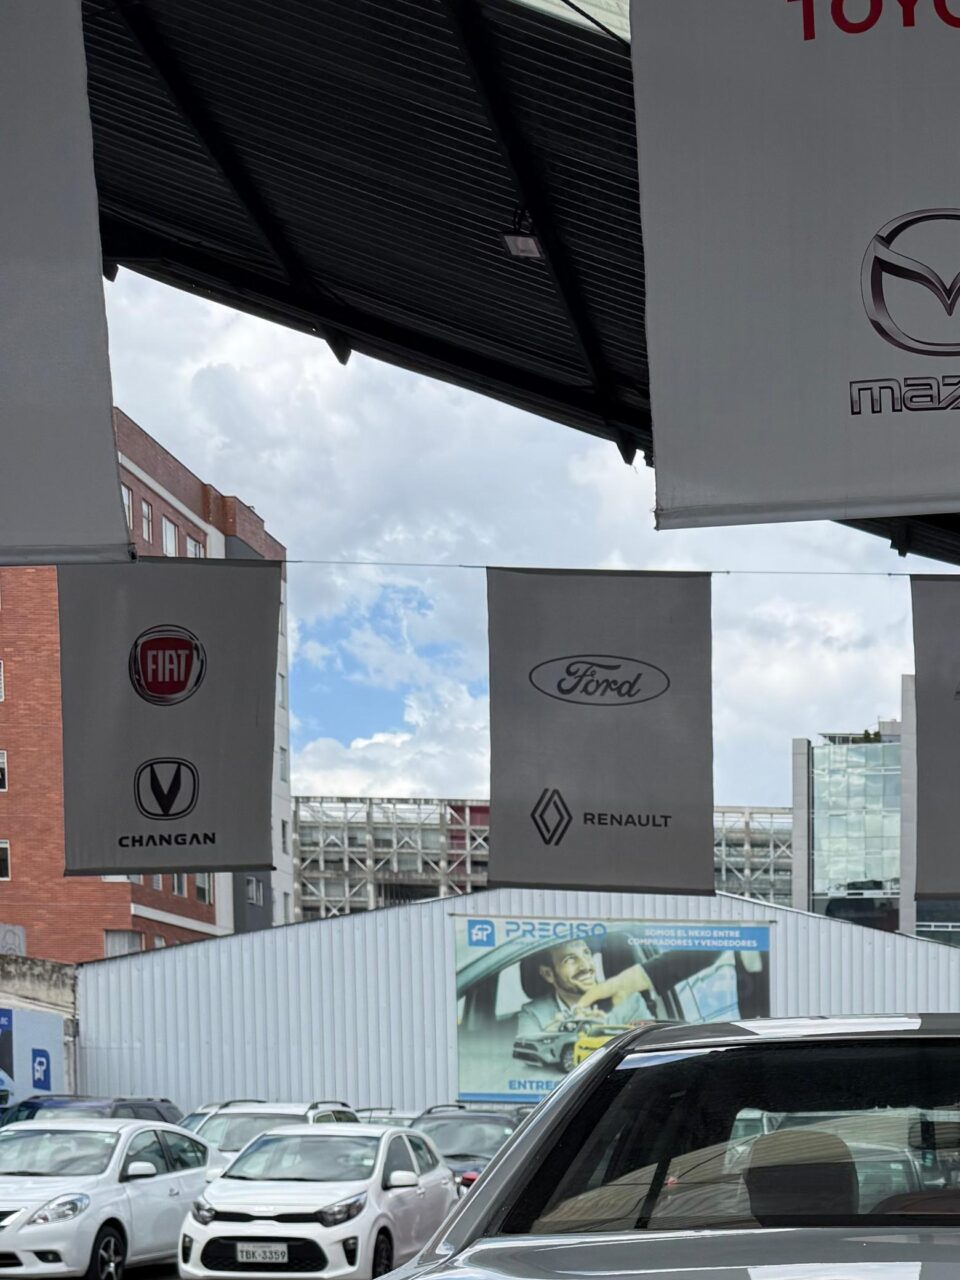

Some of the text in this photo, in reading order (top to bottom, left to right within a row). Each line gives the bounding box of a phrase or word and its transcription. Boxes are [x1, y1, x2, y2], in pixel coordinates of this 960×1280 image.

[147, 649, 190, 682] FIAT
[557, 660, 643, 698] Ford
[583, 812, 672, 828] RENAULT
[118, 832, 217, 848] CHANGAN
[505, 921, 607, 940] PRECISO
[644, 929, 740, 938] SOMOS EL NEXO ENTRE
[627, 937, 692, 946] COMPRADORES
[700, 939, 758, 948] VENDEDORES
[508, 1080, 556, 1090] ENTRE
